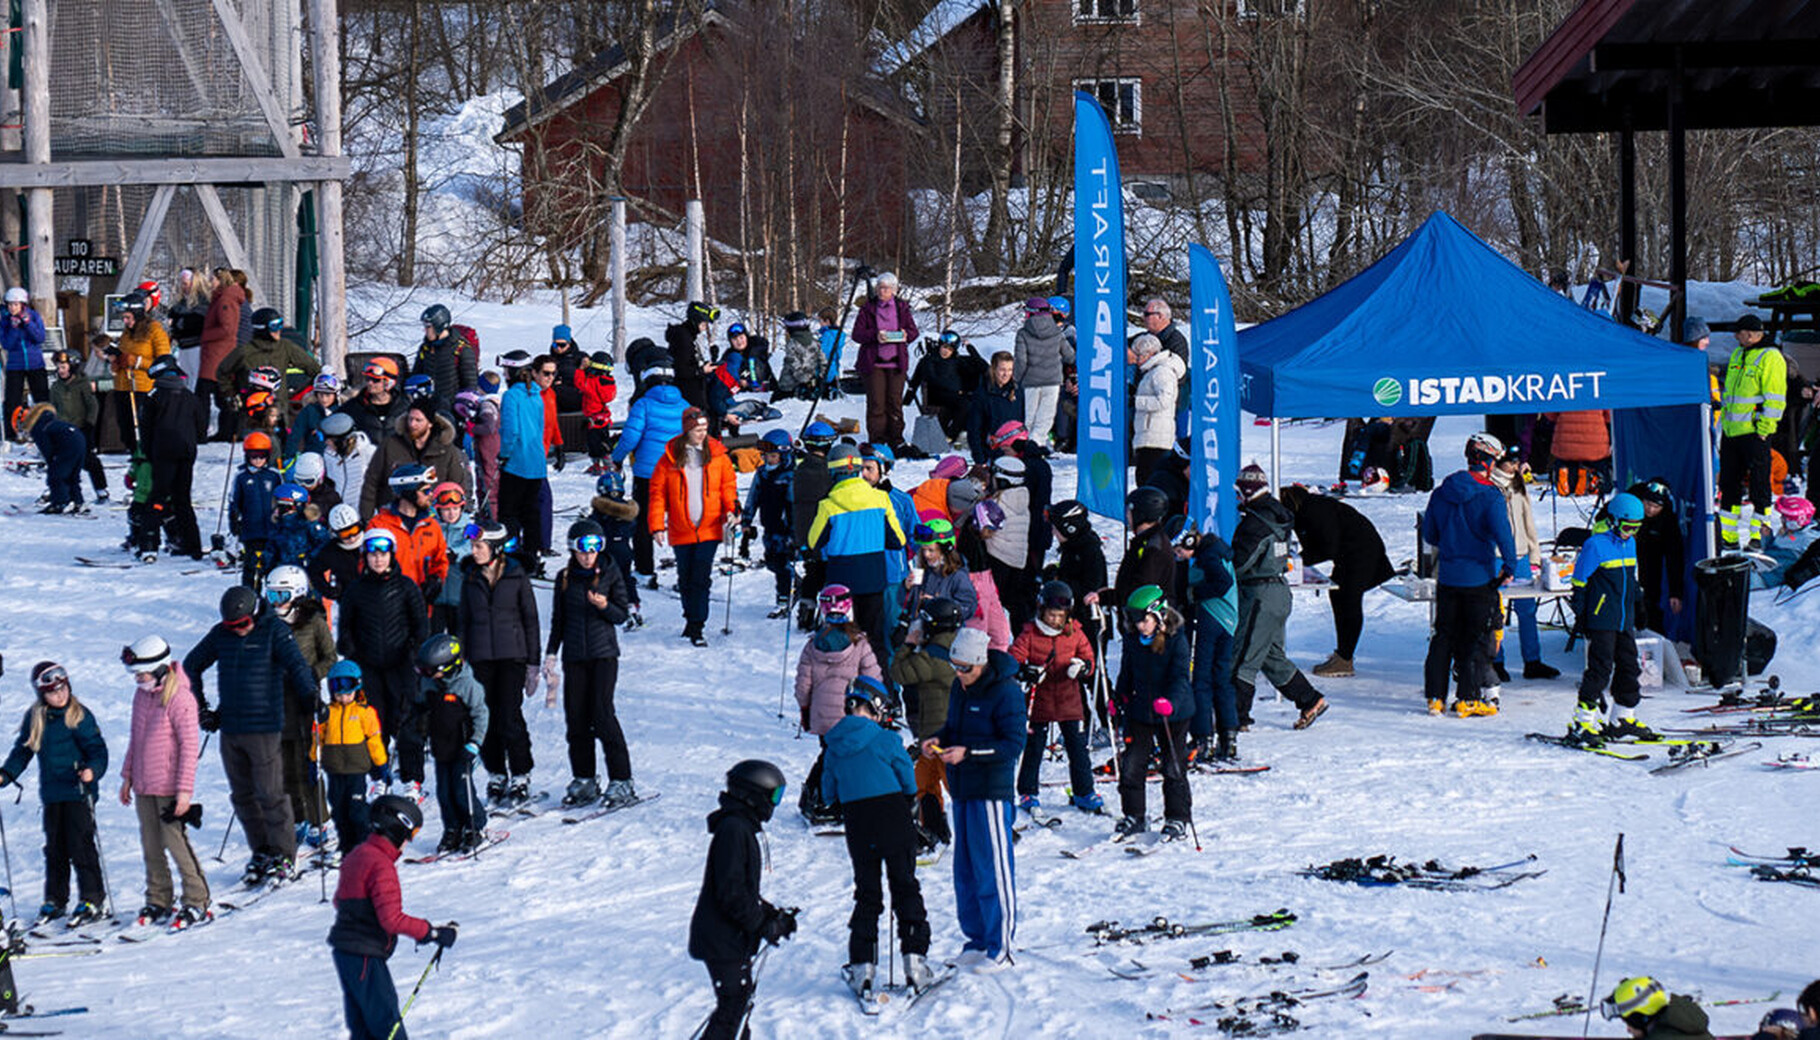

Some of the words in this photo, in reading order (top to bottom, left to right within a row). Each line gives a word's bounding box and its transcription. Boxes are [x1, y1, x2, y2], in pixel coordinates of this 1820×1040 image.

[71, 242, 88, 256] 110
[54, 259, 113, 275] AUPAREN
[1409, 371, 1607, 405] ISTADKRAFT
